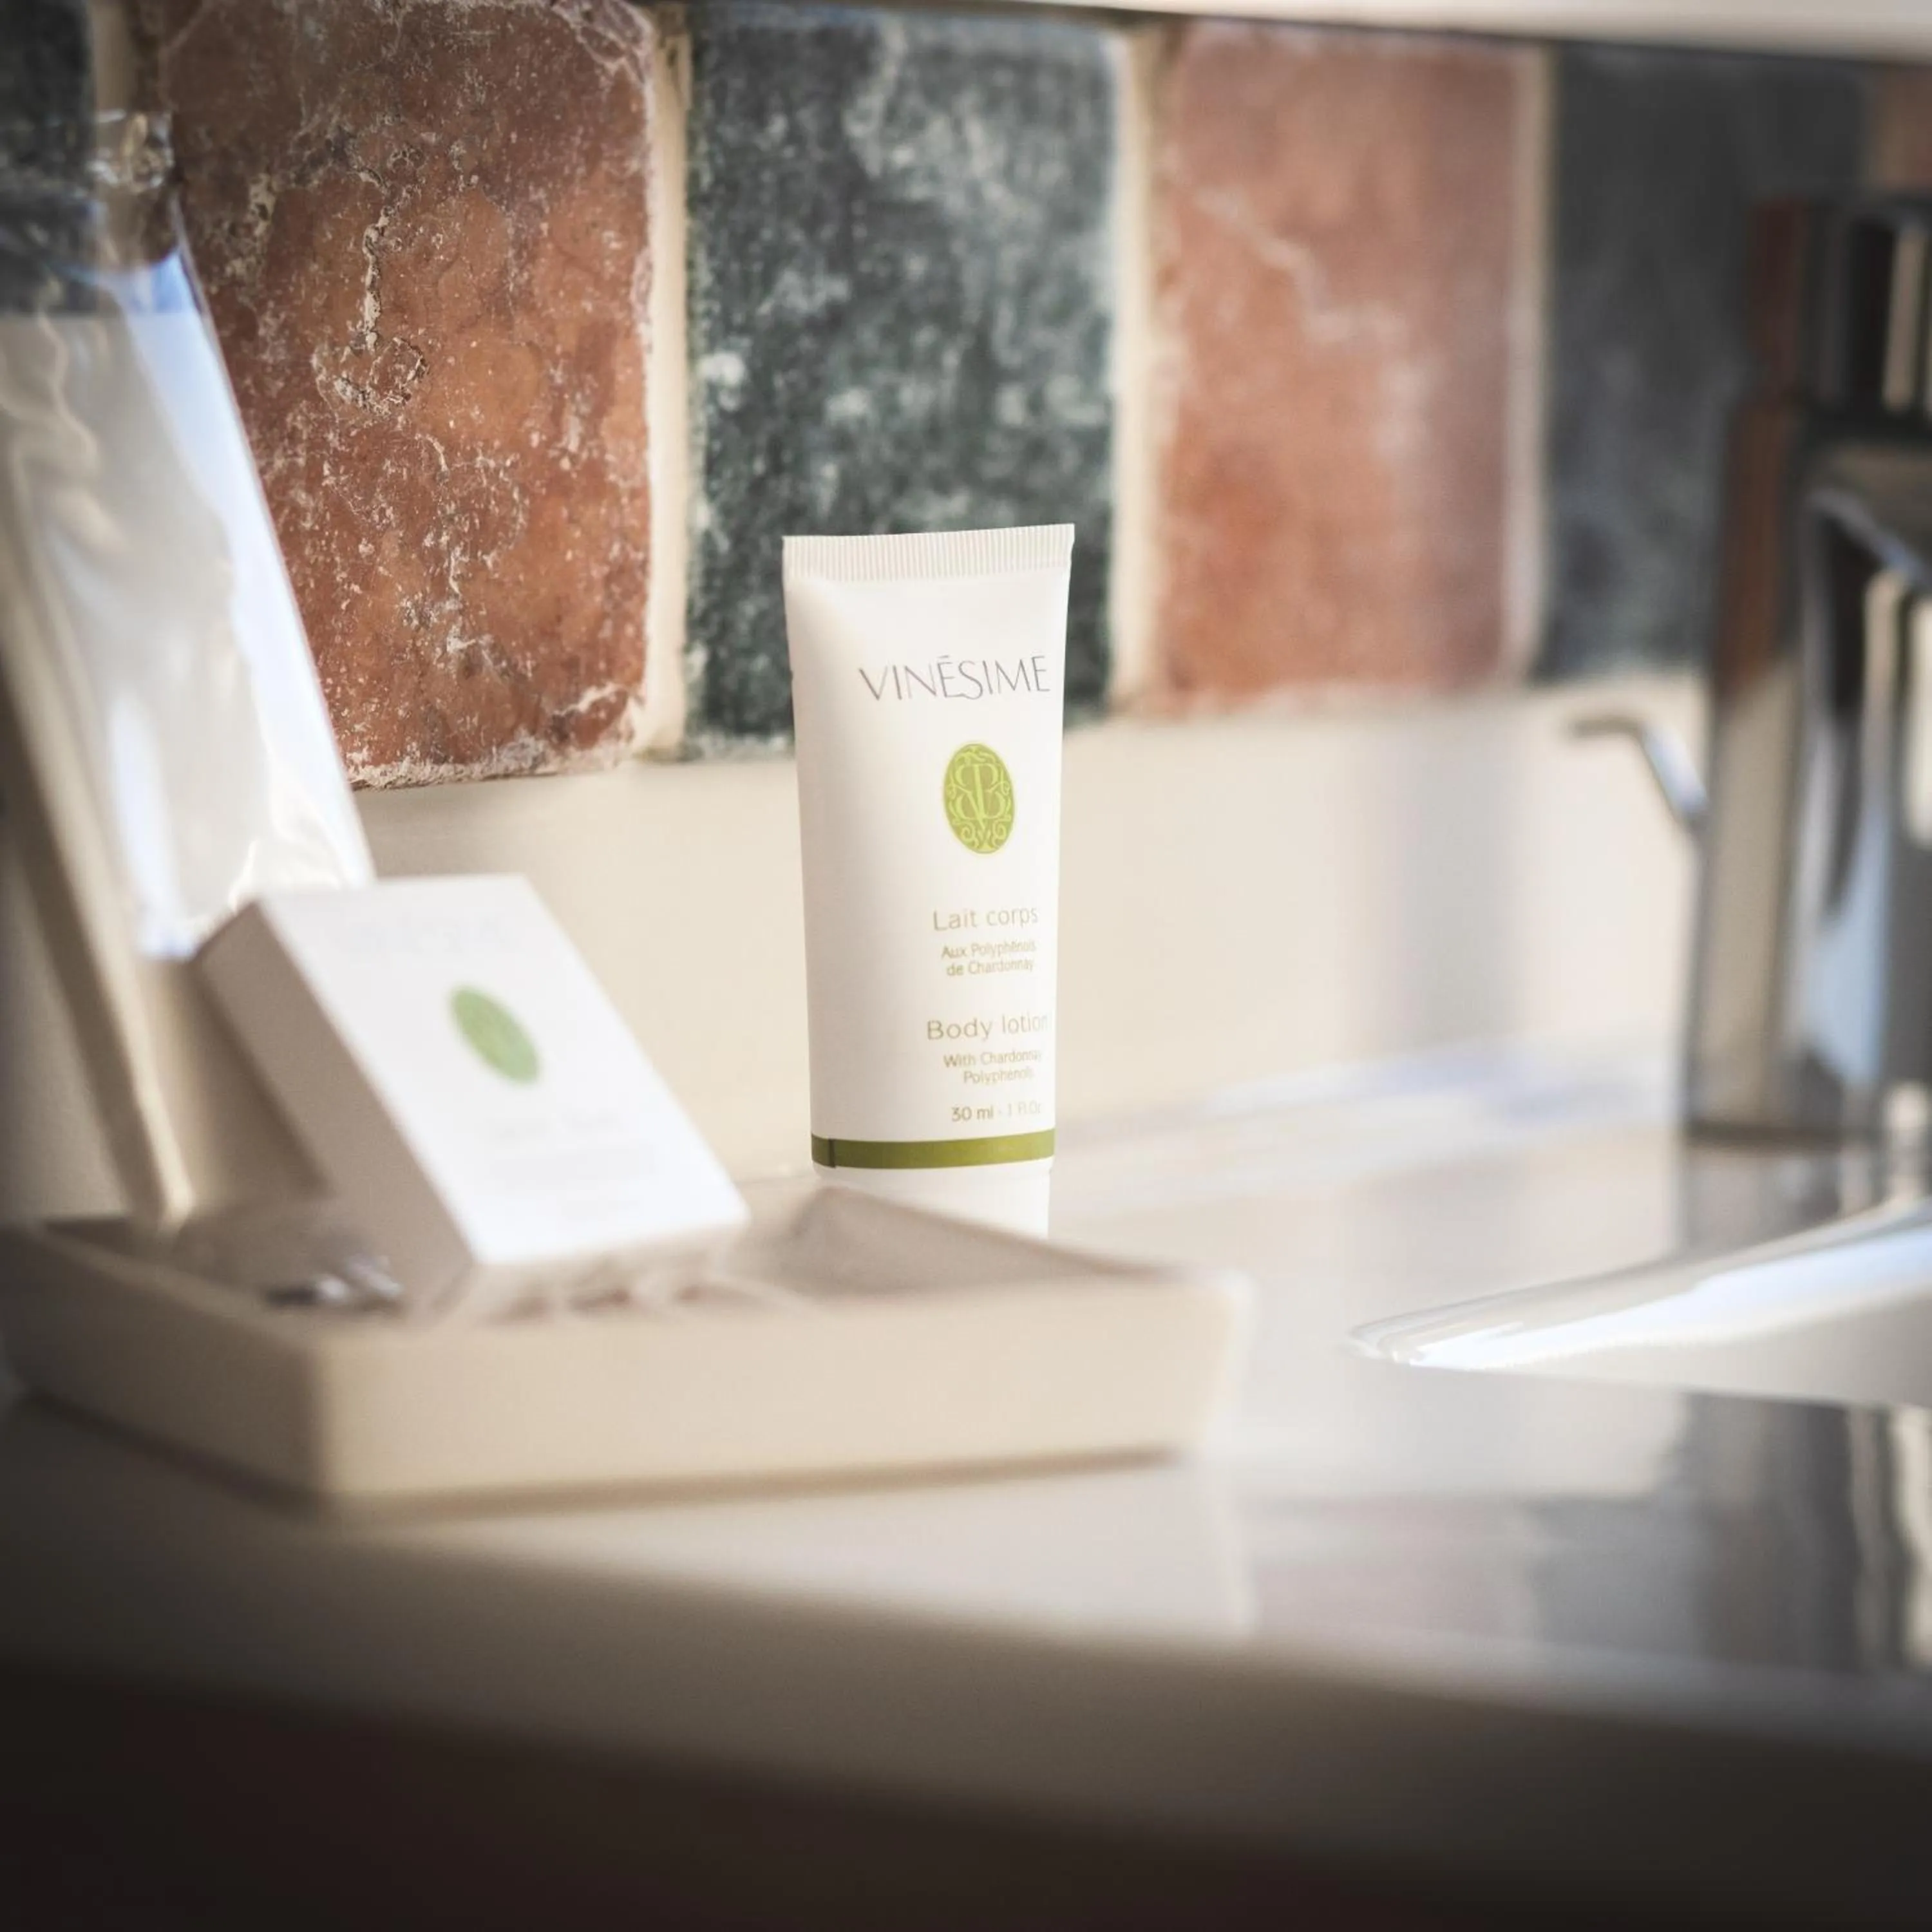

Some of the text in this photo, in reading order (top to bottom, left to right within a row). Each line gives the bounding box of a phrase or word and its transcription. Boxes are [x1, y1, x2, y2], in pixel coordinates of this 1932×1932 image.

[858, 654, 1051, 701] VINÉSIME
[933, 907, 1039, 931] Lait corps
[941, 944, 967, 960] Aux
[946, 958, 1034, 976] de Chardonnay
[927, 1012, 1048, 1041] Body lotion
[943, 1053, 976, 1068] With
[951, 1106, 972, 1122] 30
[977, 1104, 994, 1119] ml
